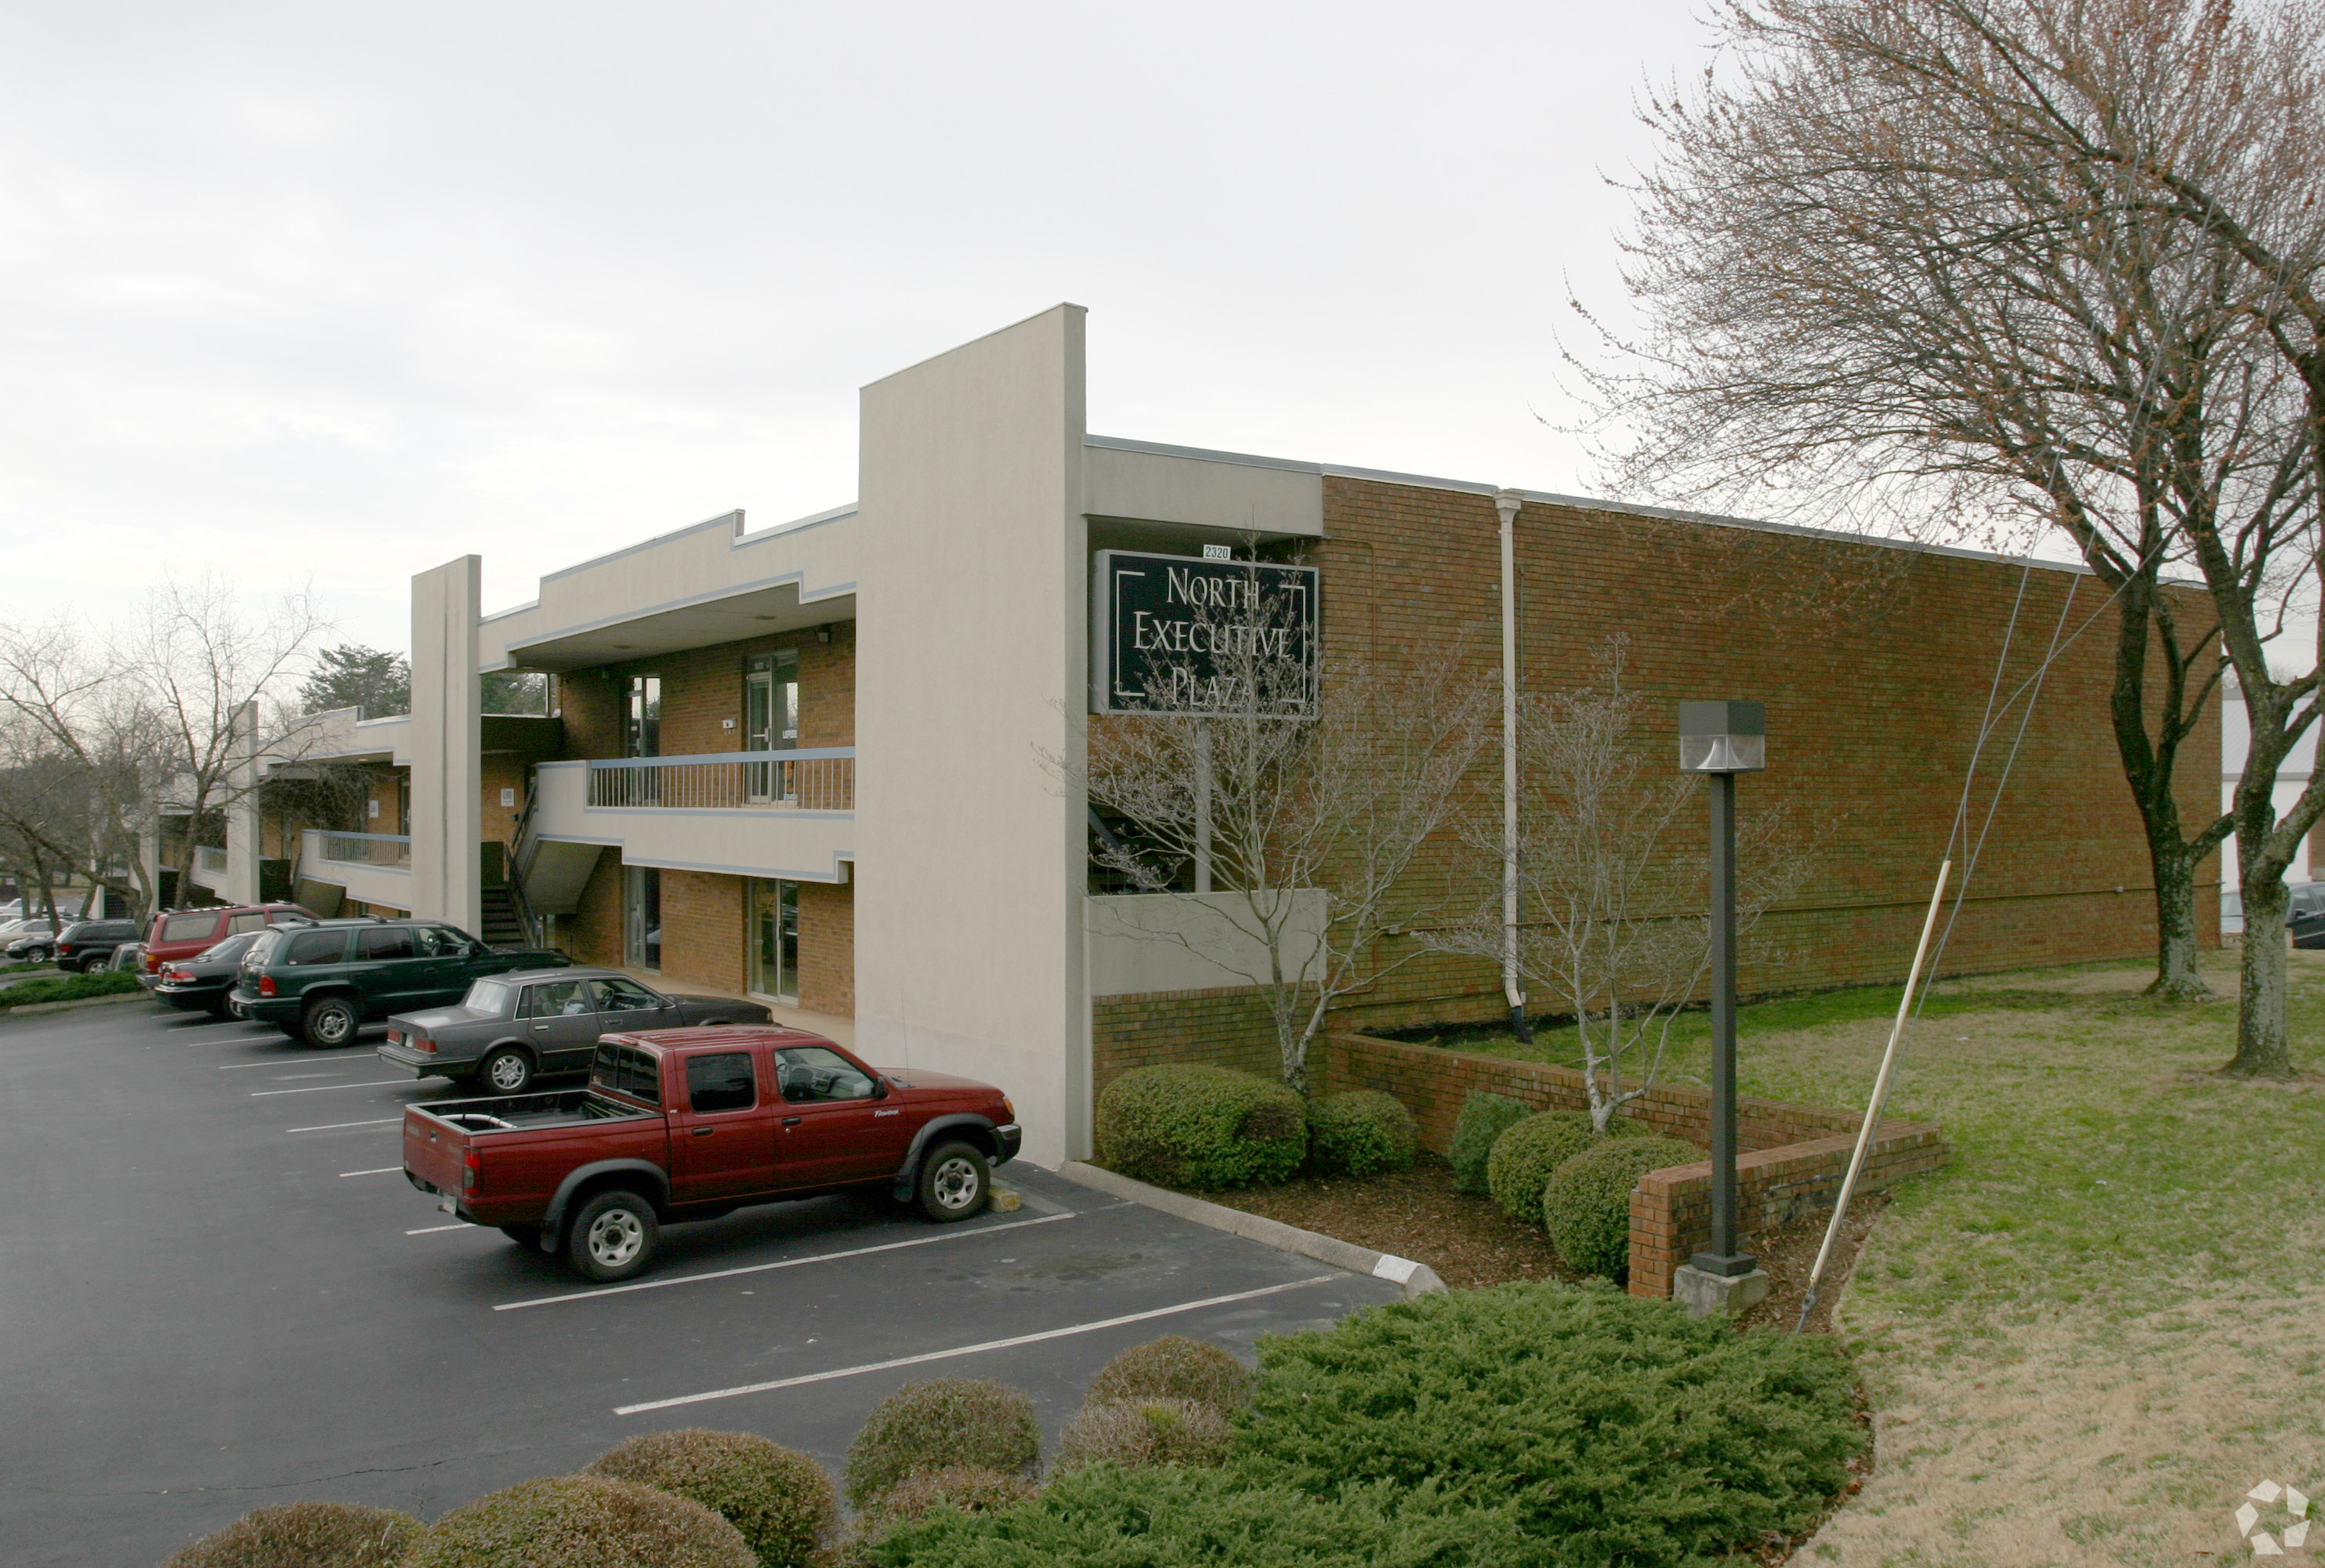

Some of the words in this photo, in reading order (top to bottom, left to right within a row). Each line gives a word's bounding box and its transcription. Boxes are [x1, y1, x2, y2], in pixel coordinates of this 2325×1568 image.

[1205, 546, 1229, 559] 2320
[1166, 567, 1260, 610] NORTH
[1133, 610, 1291, 658] EXECUTIVE
